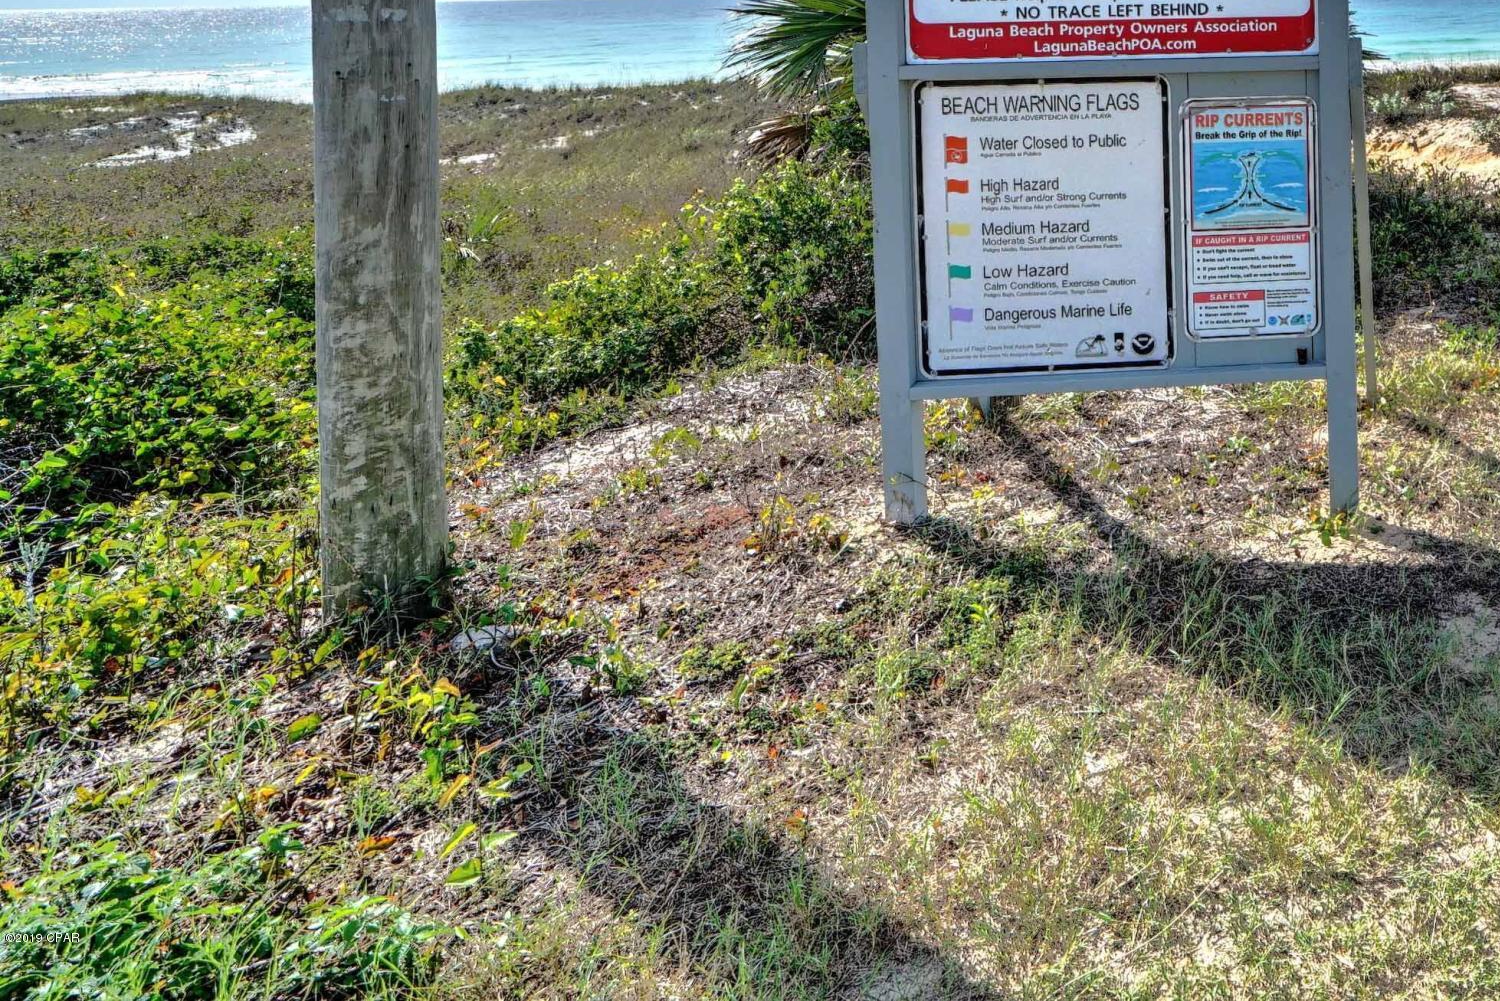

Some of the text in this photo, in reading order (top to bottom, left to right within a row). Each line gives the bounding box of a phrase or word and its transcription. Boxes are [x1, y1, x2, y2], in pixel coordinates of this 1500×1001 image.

[1016, 3, 1209, 19] NO TRACE LEFT BEHIND
[949, 19, 1278, 42] Laguna Beach Property Owners Association
[1034, 38, 1197, 56] LagunaBeachPOA.com
[941, 93, 1140, 115] BEACH WARNING FLAGS
[1195, 112, 1303, 127] RIP CURRENTS
[979, 134, 1127, 151] Water Closed to Public
[1195, 129, 1302, 140] Break the Grip of the Rip!
[980, 177, 1060, 196] High Hazard
[981, 191, 1127, 205] High Surf and/or Strong Currents
[981, 219, 1090, 236] Medium Hazard
[982, 234, 1118, 246] Moderate Surf and/or Currents
[1205, 237, 1236, 245] CAUGHT
[983, 263, 1069, 279] Low Hazard
[984, 282, 1007, 291] Calm
[1062, 279, 1100, 288] Exercise
[1102, 278, 1136, 287] Caution
[1209, 292, 1249, 301] SAFETY
[984, 302, 1133, 324] Dangerous Marine Life
